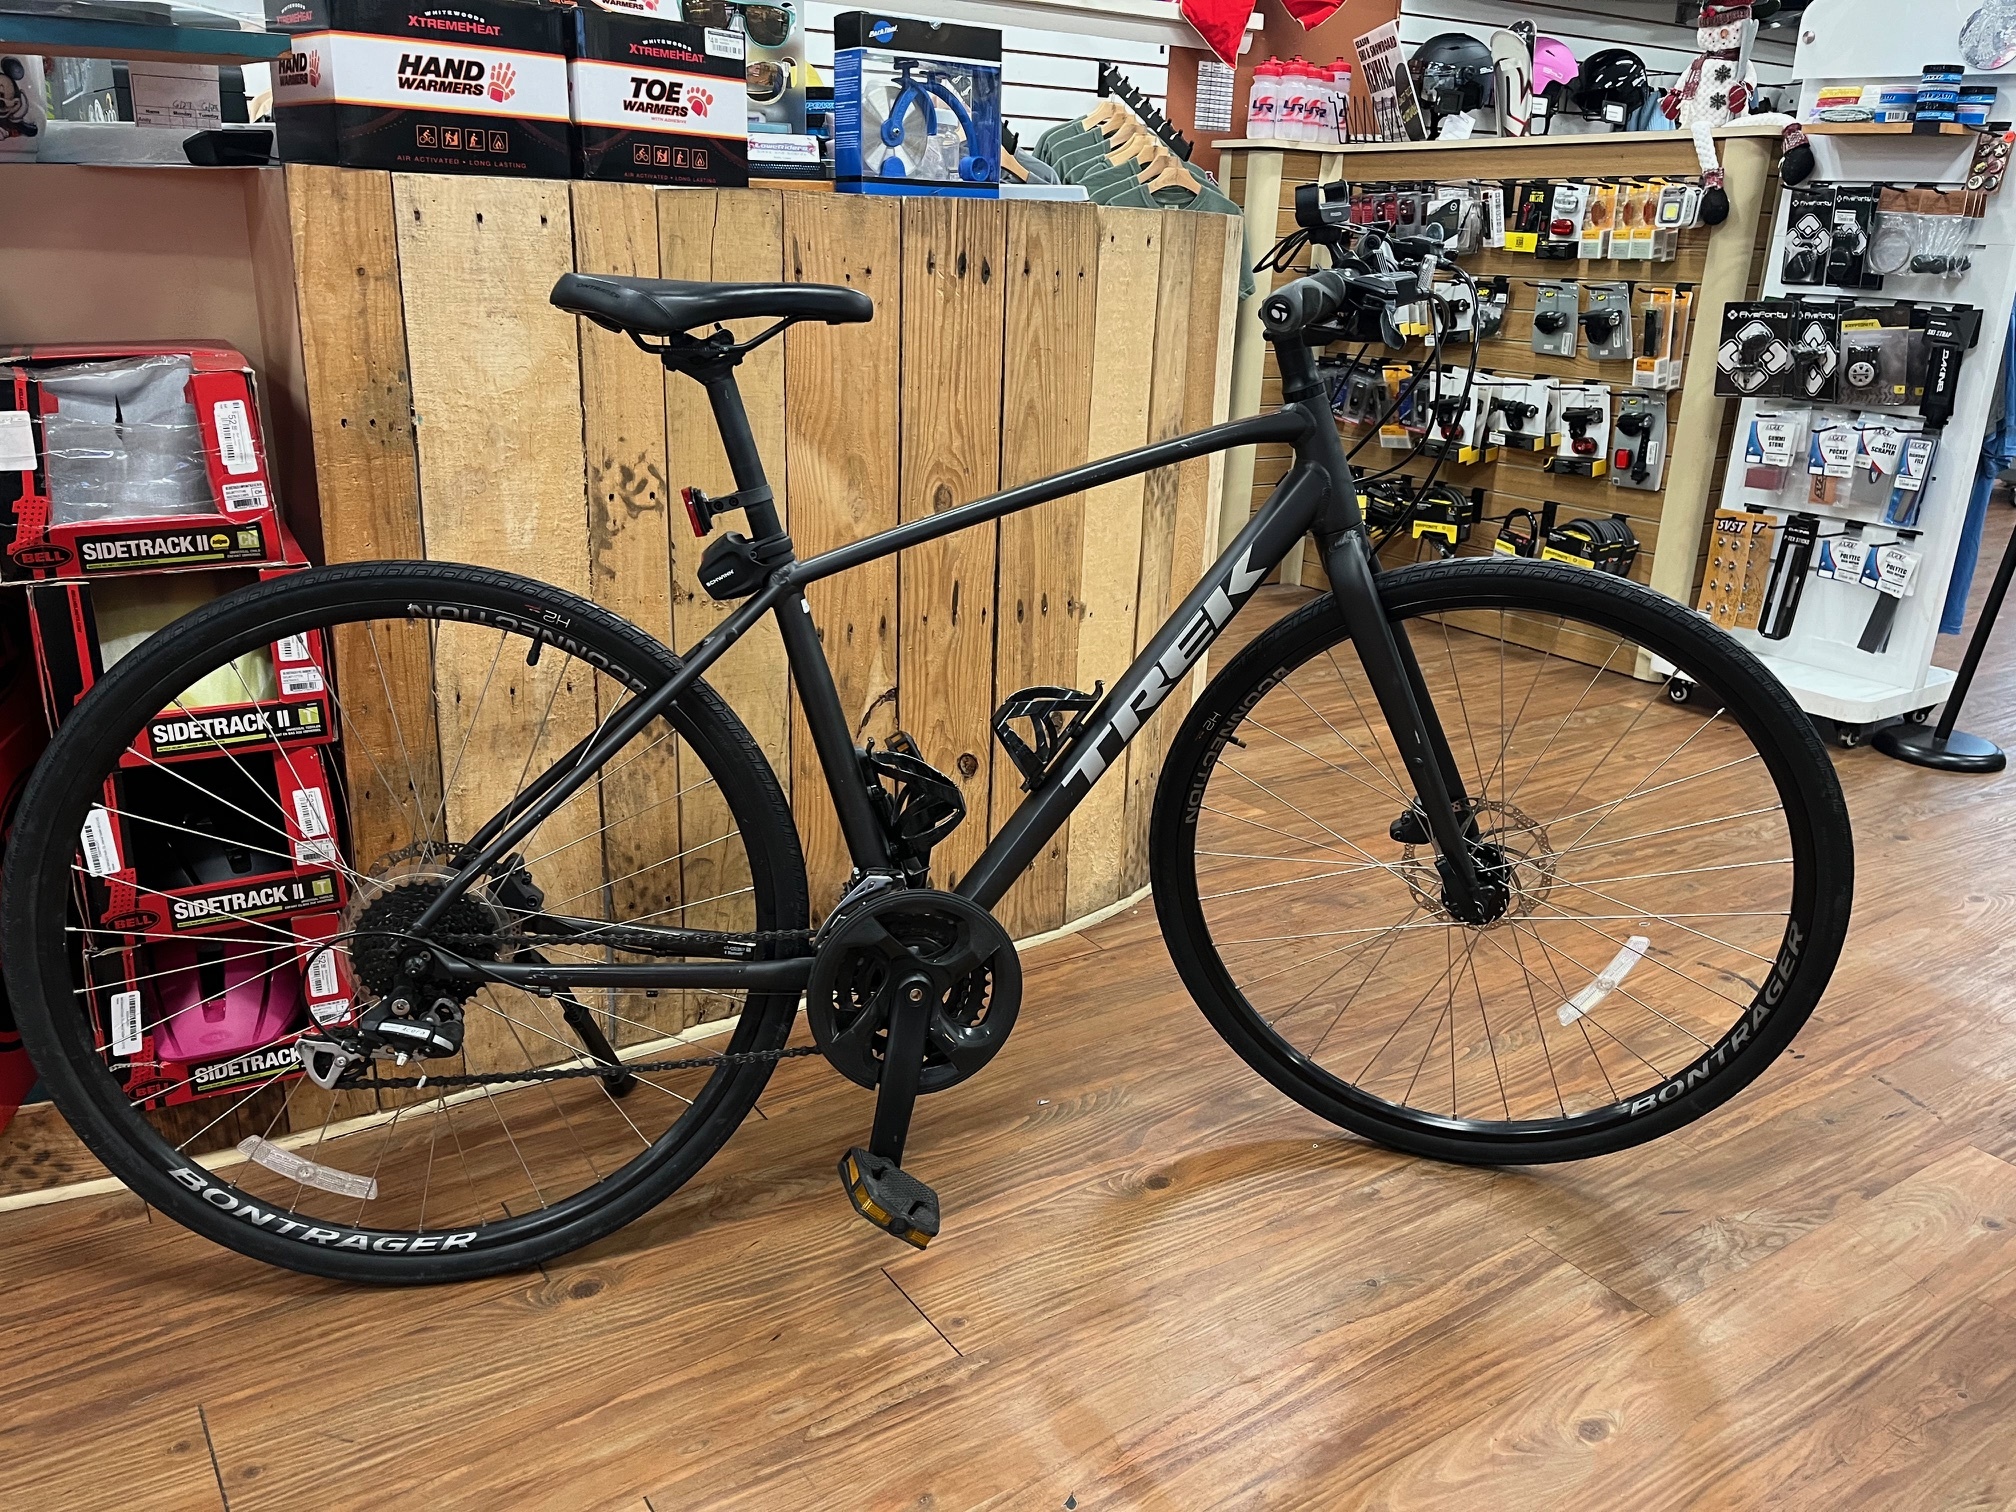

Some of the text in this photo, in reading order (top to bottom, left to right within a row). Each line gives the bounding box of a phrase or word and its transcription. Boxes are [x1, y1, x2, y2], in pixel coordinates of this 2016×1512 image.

[408, 15, 501, 36] XTREMEHEAT
[424, 9, 485, 23] WHITEWOODS
[629, 43, 705, 63] XTREMEHEAT
[642, 39, 692, 52] WHITEWOODS
[398, 54, 485, 81] HAND
[1362, 55, 1395, 94] RENTALS
[398, 76, 485, 96] WARMERS
[630, 77, 683, 103] TOE
[623, 99, 689, 117] WARMERS
[414, 156, 460, 165] ACTIVATED
[494, 161, 527, 169] LASTING
[1936, 348, 1950, 393] DAKINE
[1871, 446, 1896, 456] SCRAPER
[1717, 520, 1746, 533] SVST
[22, 551, 65, 564] BELL
[82, 535, 209, 561] SIDETRACK II
[706, 569, 734, 587] SCHWINN
[411, 604, 630, 680] CONNECTION
[1061, 543, 1267, 788] TREK
[153, 709, 290, 743] SIDETRACK II
[1203, 711, 1221, 731] H2
[1185, 677, 1277, 824] CONNECTION
[174, 886, 288, 920] SIDETRACK
[292, 883, 304, 900] II
[114, 914, 152, 930] BELL
[1630, 920, 1804, 1118] BONTRAGER
[195, 1047, 301, 1084] SIDETRACK
[167, 1167, 478, 1253] BONTRAGER
